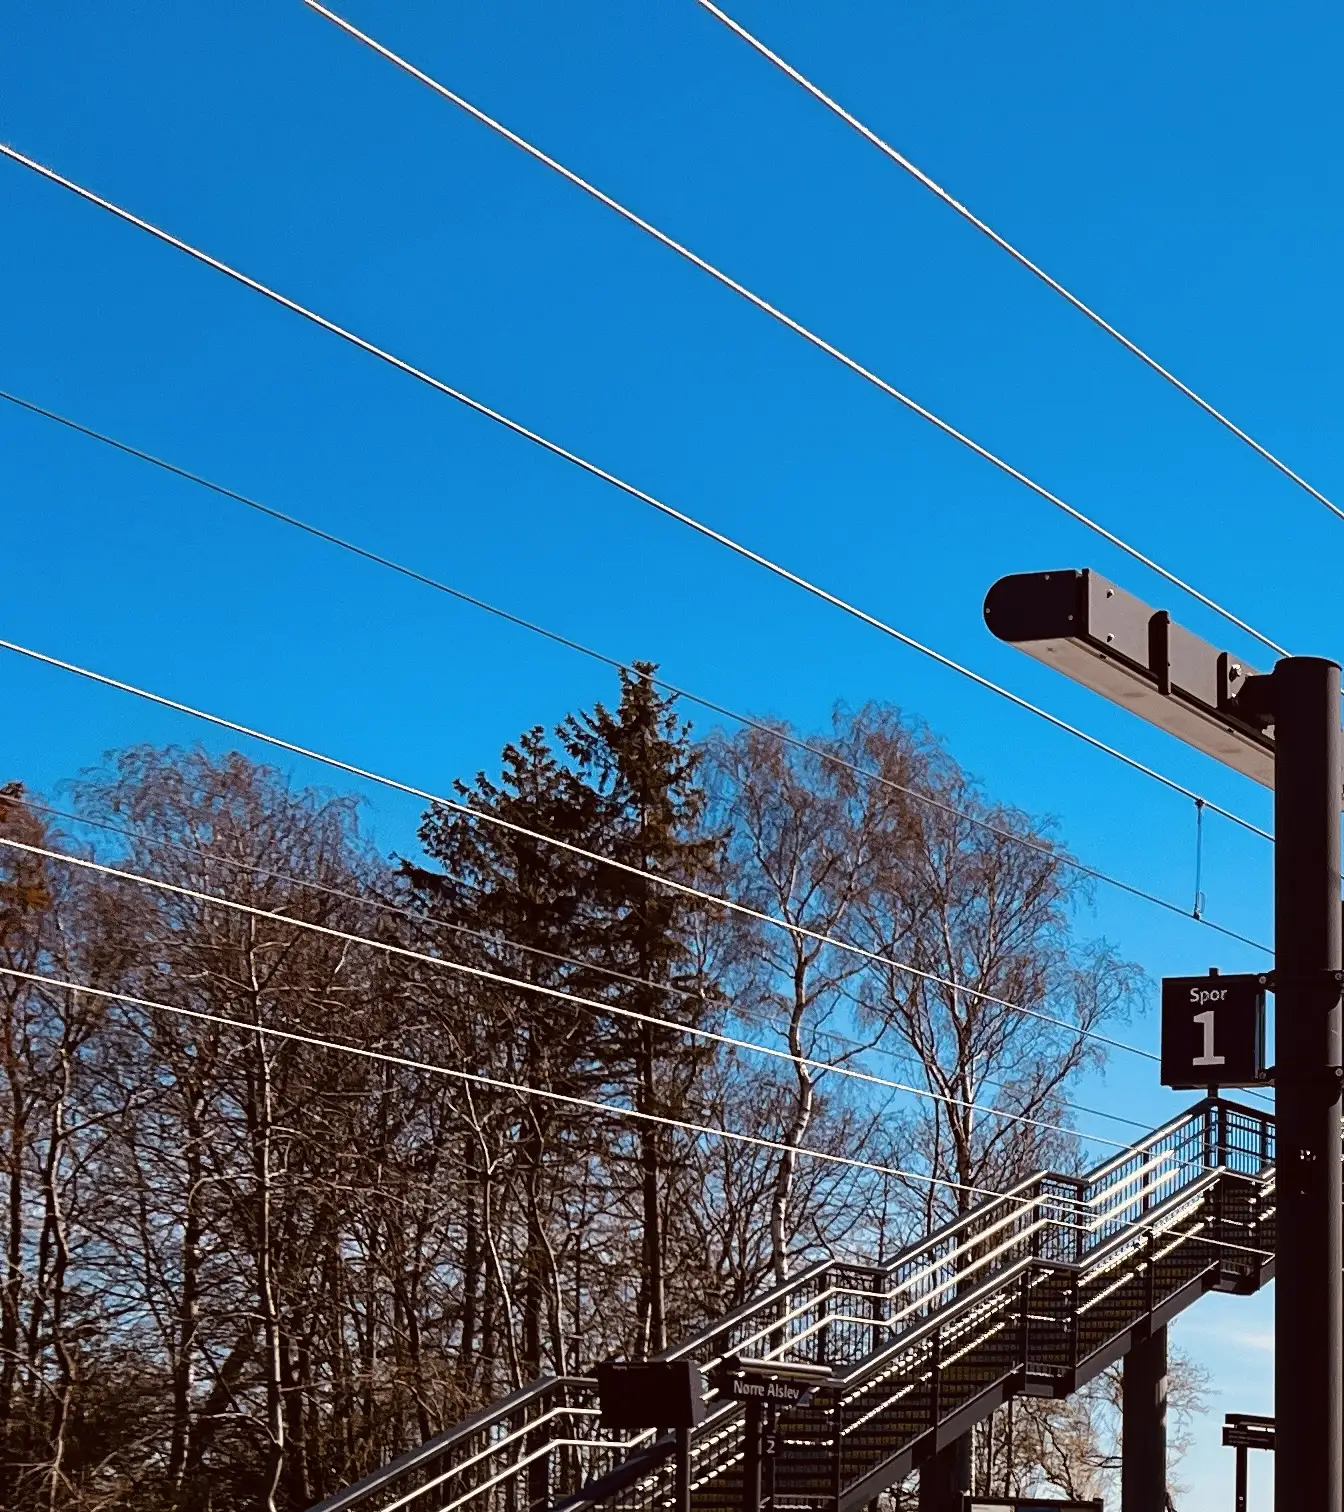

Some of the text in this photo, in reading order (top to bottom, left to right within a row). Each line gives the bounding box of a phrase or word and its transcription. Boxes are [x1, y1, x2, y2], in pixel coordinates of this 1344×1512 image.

[1190, 988, 1228, 1005] Spor
[1193, 1011, 1225, 1066] 1
[767, 1383, 800, 1400] Alslev
[766, 1439, 776, 1454] 2
